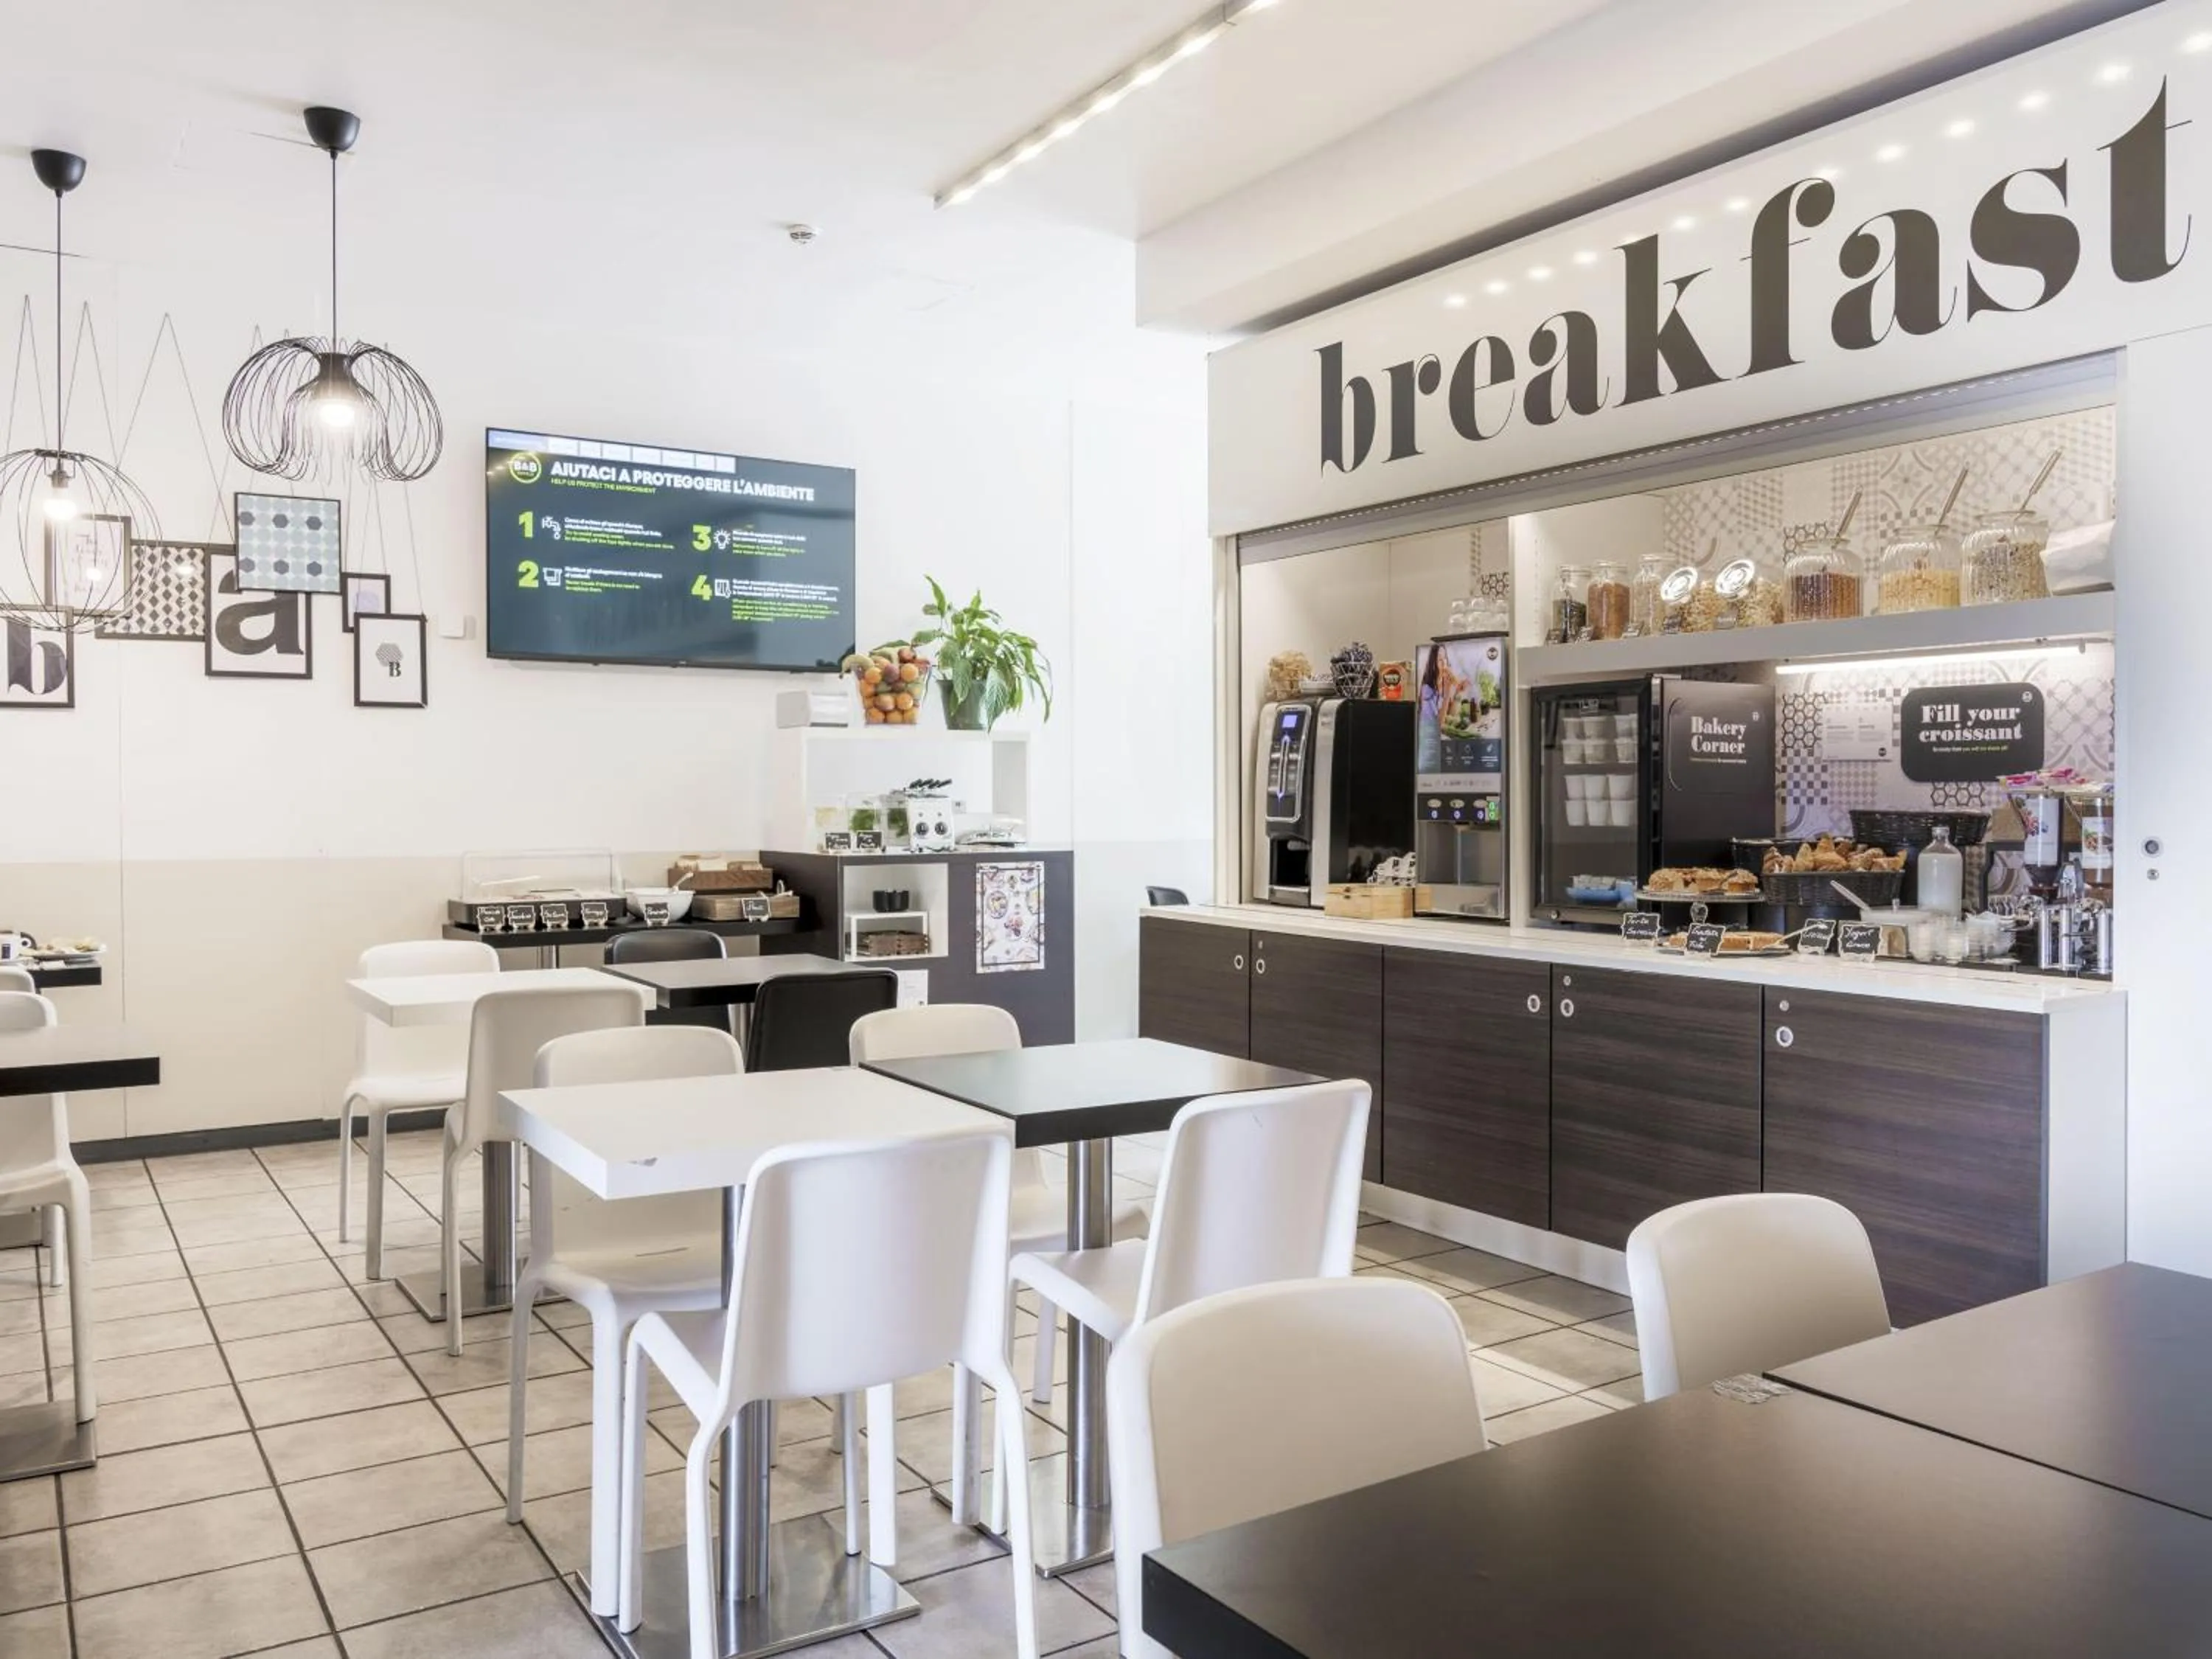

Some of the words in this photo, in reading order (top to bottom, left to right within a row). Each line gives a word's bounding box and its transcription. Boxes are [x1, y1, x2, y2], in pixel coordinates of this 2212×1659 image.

[1314, 74, 2192, 479] breakfast
[551, 461, 615, 481] AIUTACI
[618, 467, 631, 483] A
[633, 470, 731, 493] PROTEGGERE
[733, 479, 815, 501] L'AMBIENTE
[518, 510, 534, 539] 1
[692, 524, 712, 552] 3
[518, 560, 539, 588] 2
[691, 574, 713, 601] 4
[1691, 716, 1747, 740] Bakery
[1921, 703, 1960, 723] Fill
[1967, 707, 2021, 727] your
[1691, 734, 1745, 754] Corner
[1919, 723, 2023, 742] croissant
